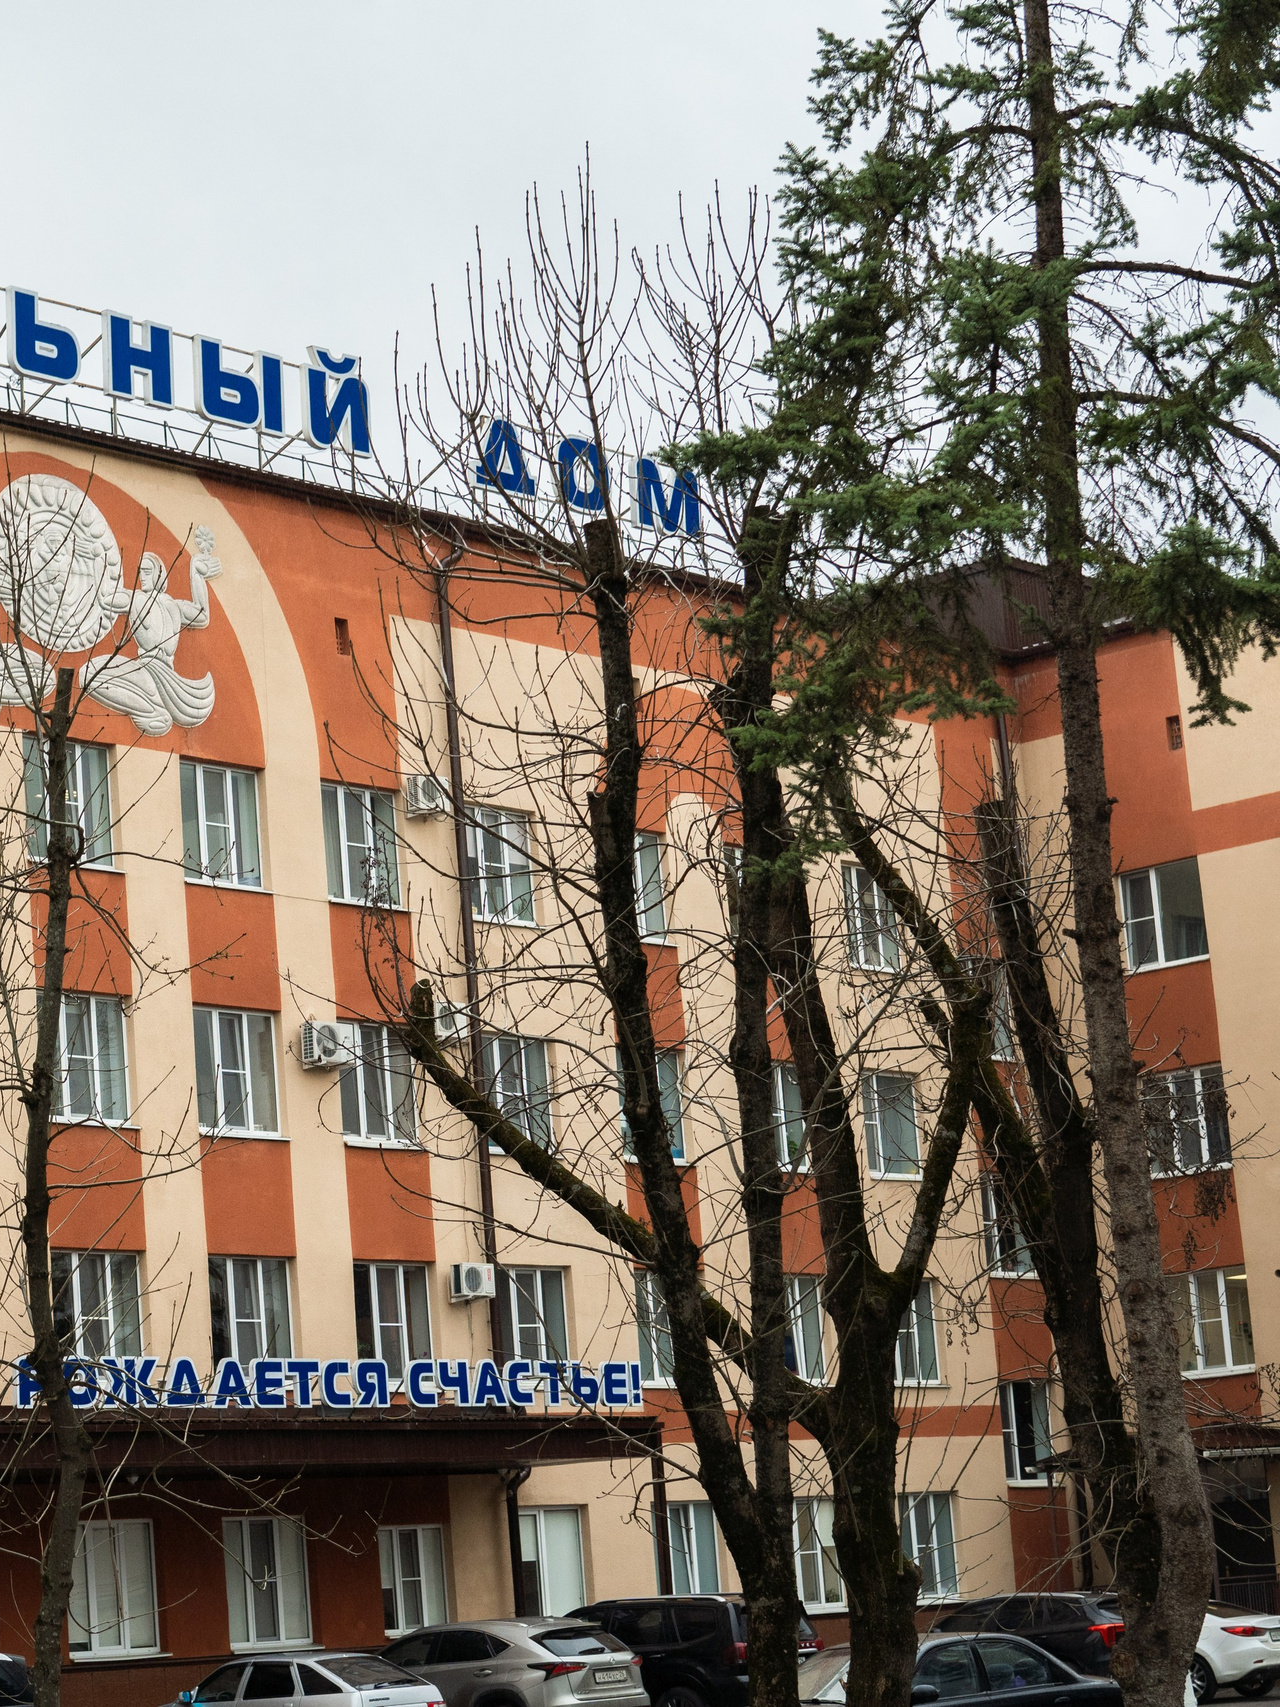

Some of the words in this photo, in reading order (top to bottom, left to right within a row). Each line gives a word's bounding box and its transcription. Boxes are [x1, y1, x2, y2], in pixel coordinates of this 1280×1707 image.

[470, 416, 702, 538] ДОМ
[13, 1355, 391, 1409] РОЖДАЕТСЯ
[404, 1358, 643, 1408] СЧАСТЬЕ!
